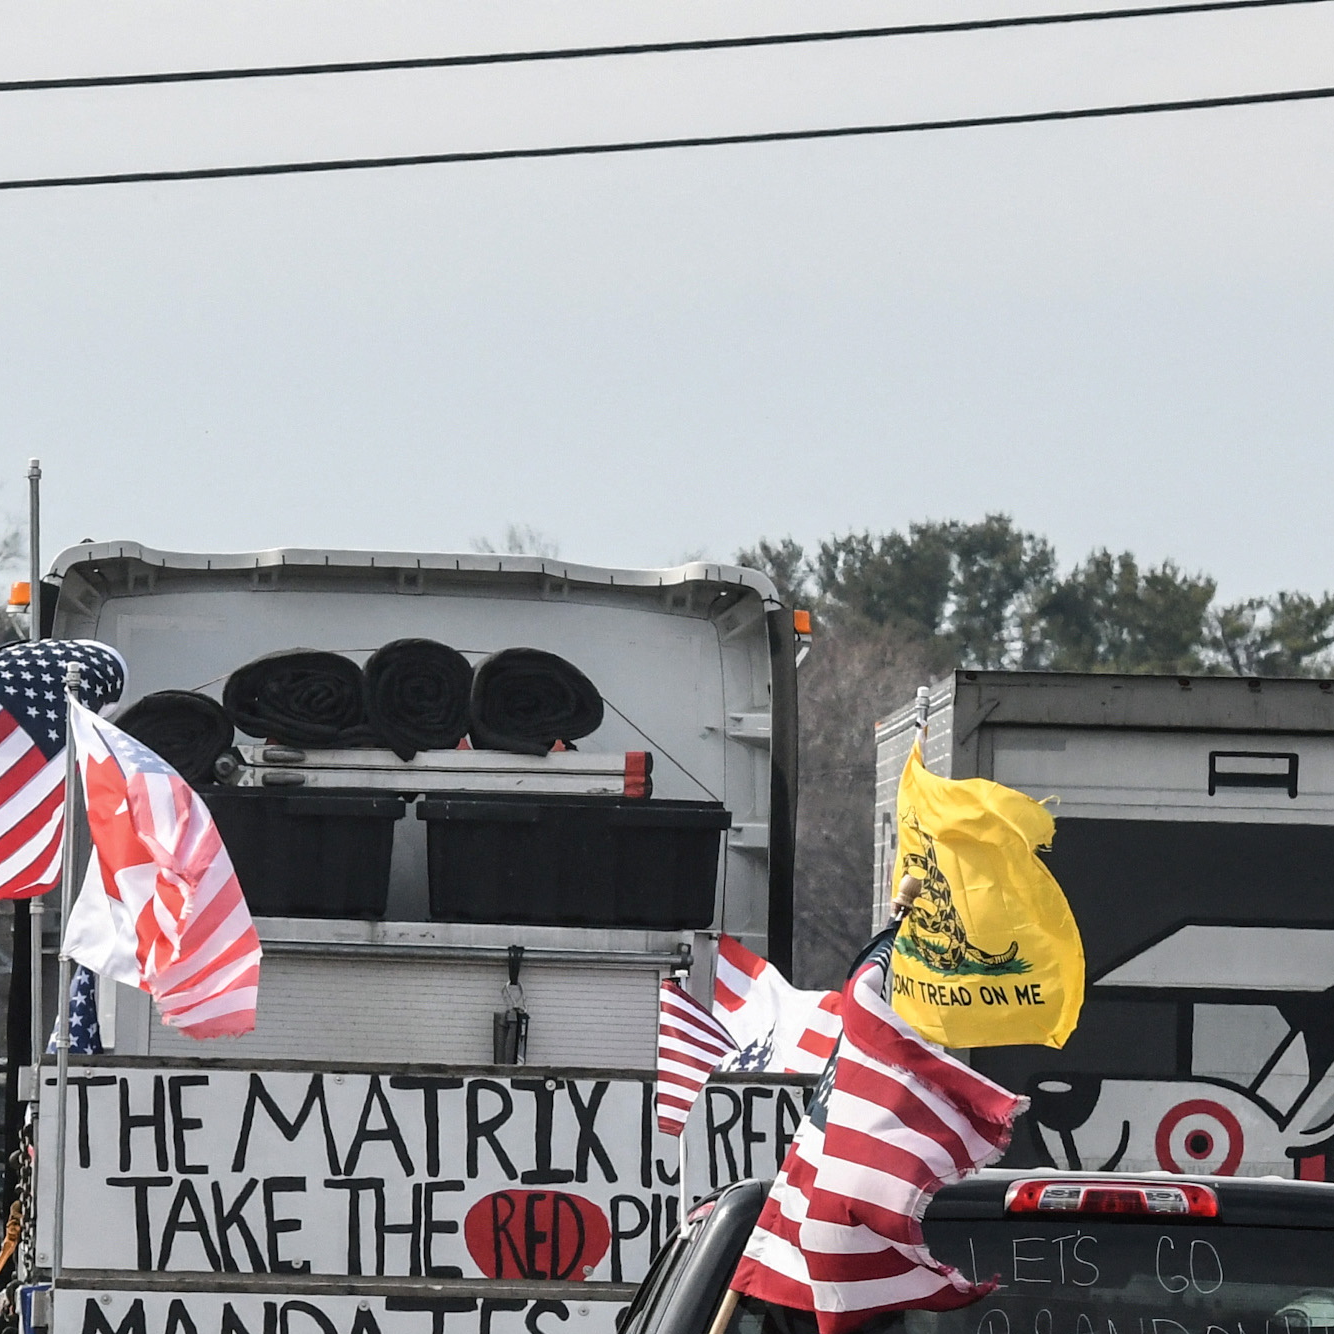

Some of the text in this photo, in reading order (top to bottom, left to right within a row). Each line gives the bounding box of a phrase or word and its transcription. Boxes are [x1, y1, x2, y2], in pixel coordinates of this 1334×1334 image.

[918, 981, 972, 1007] TREAD
[979, 985, 1010, 1005] ON
[1014, 983, 1046, 1006] ME
[45, 1074, 210, 1175] THE
[231, 1073, 618, 1184] MATRIX
[705, 1083, 815, 1189] REA
[105, 1176, 703, 1284] TAKE THE RED PI
[969, 1229, 1224, 1294] LET'S GO
